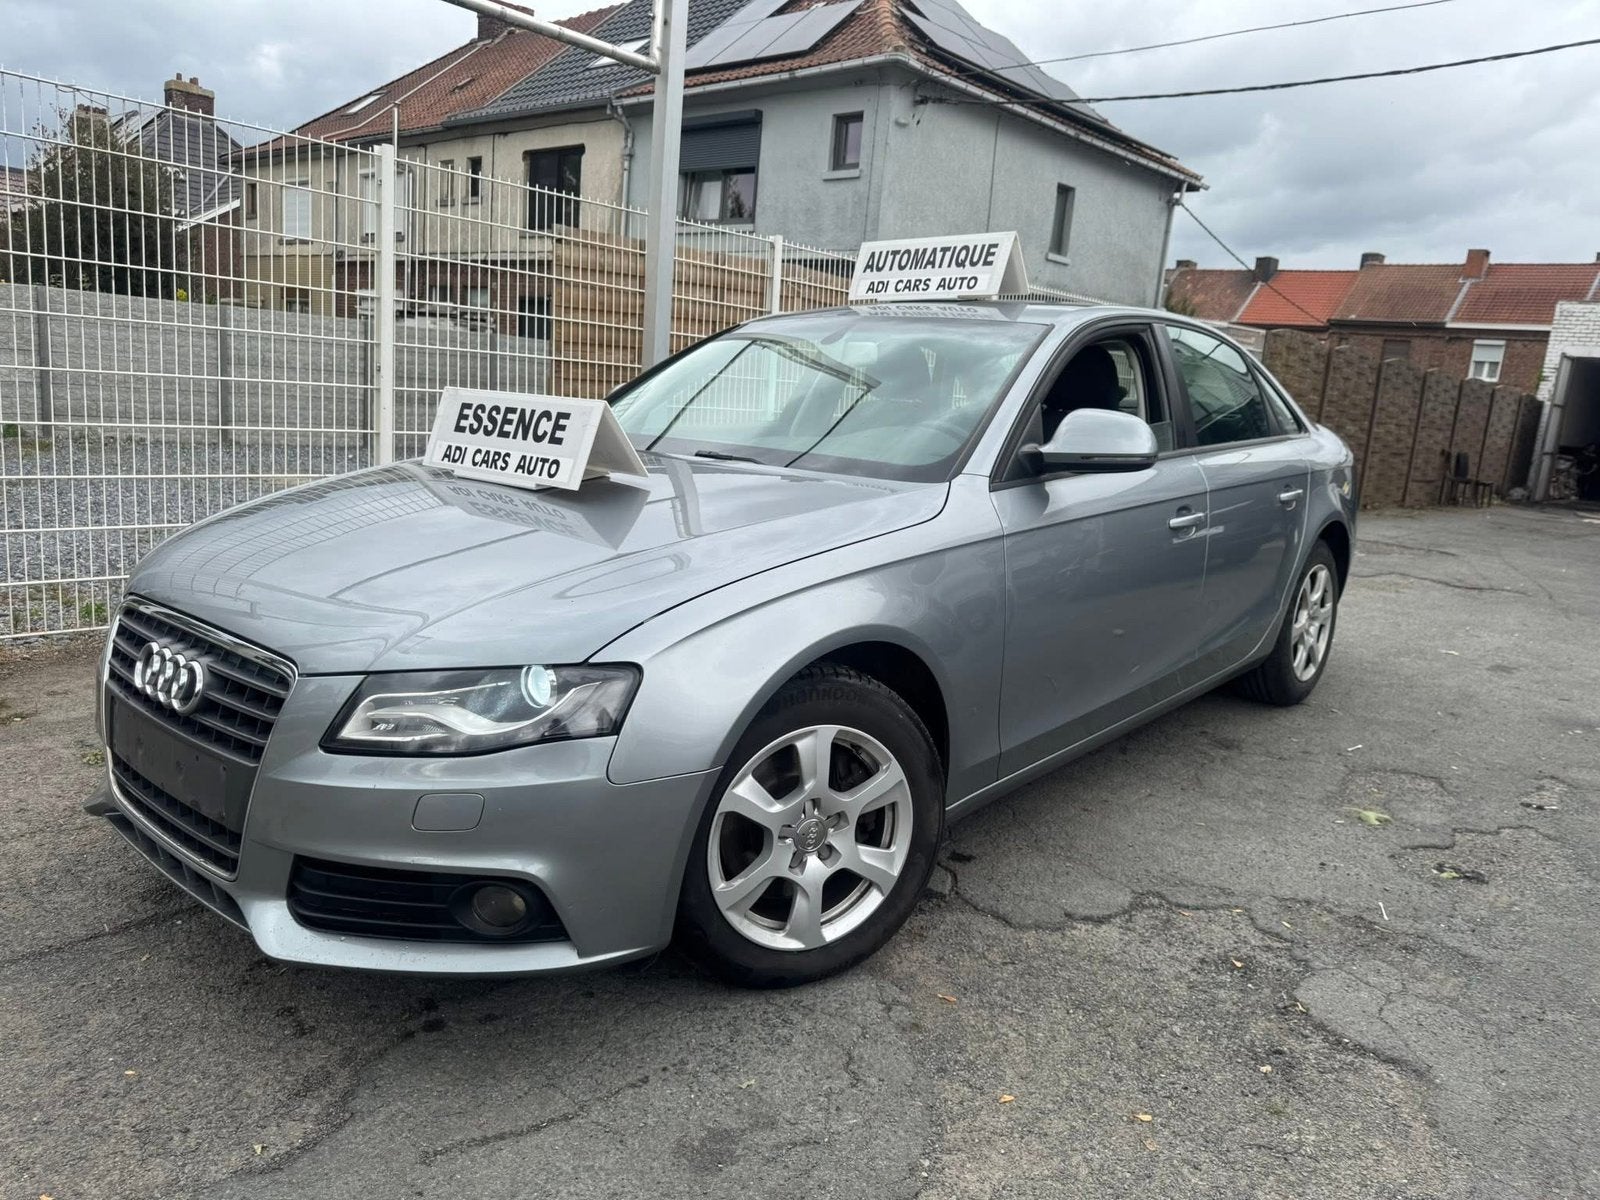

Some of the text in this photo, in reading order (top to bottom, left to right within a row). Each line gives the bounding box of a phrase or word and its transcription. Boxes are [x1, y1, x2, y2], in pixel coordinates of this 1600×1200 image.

[862, 243, 999, 273] AUTOMATIQUE
[865, 276, 978, 294] ADI CARS AUTO
[453, 402, 572, 446] ESSENCE
[441, 445, 561, 479] ADI CARS AUTO
